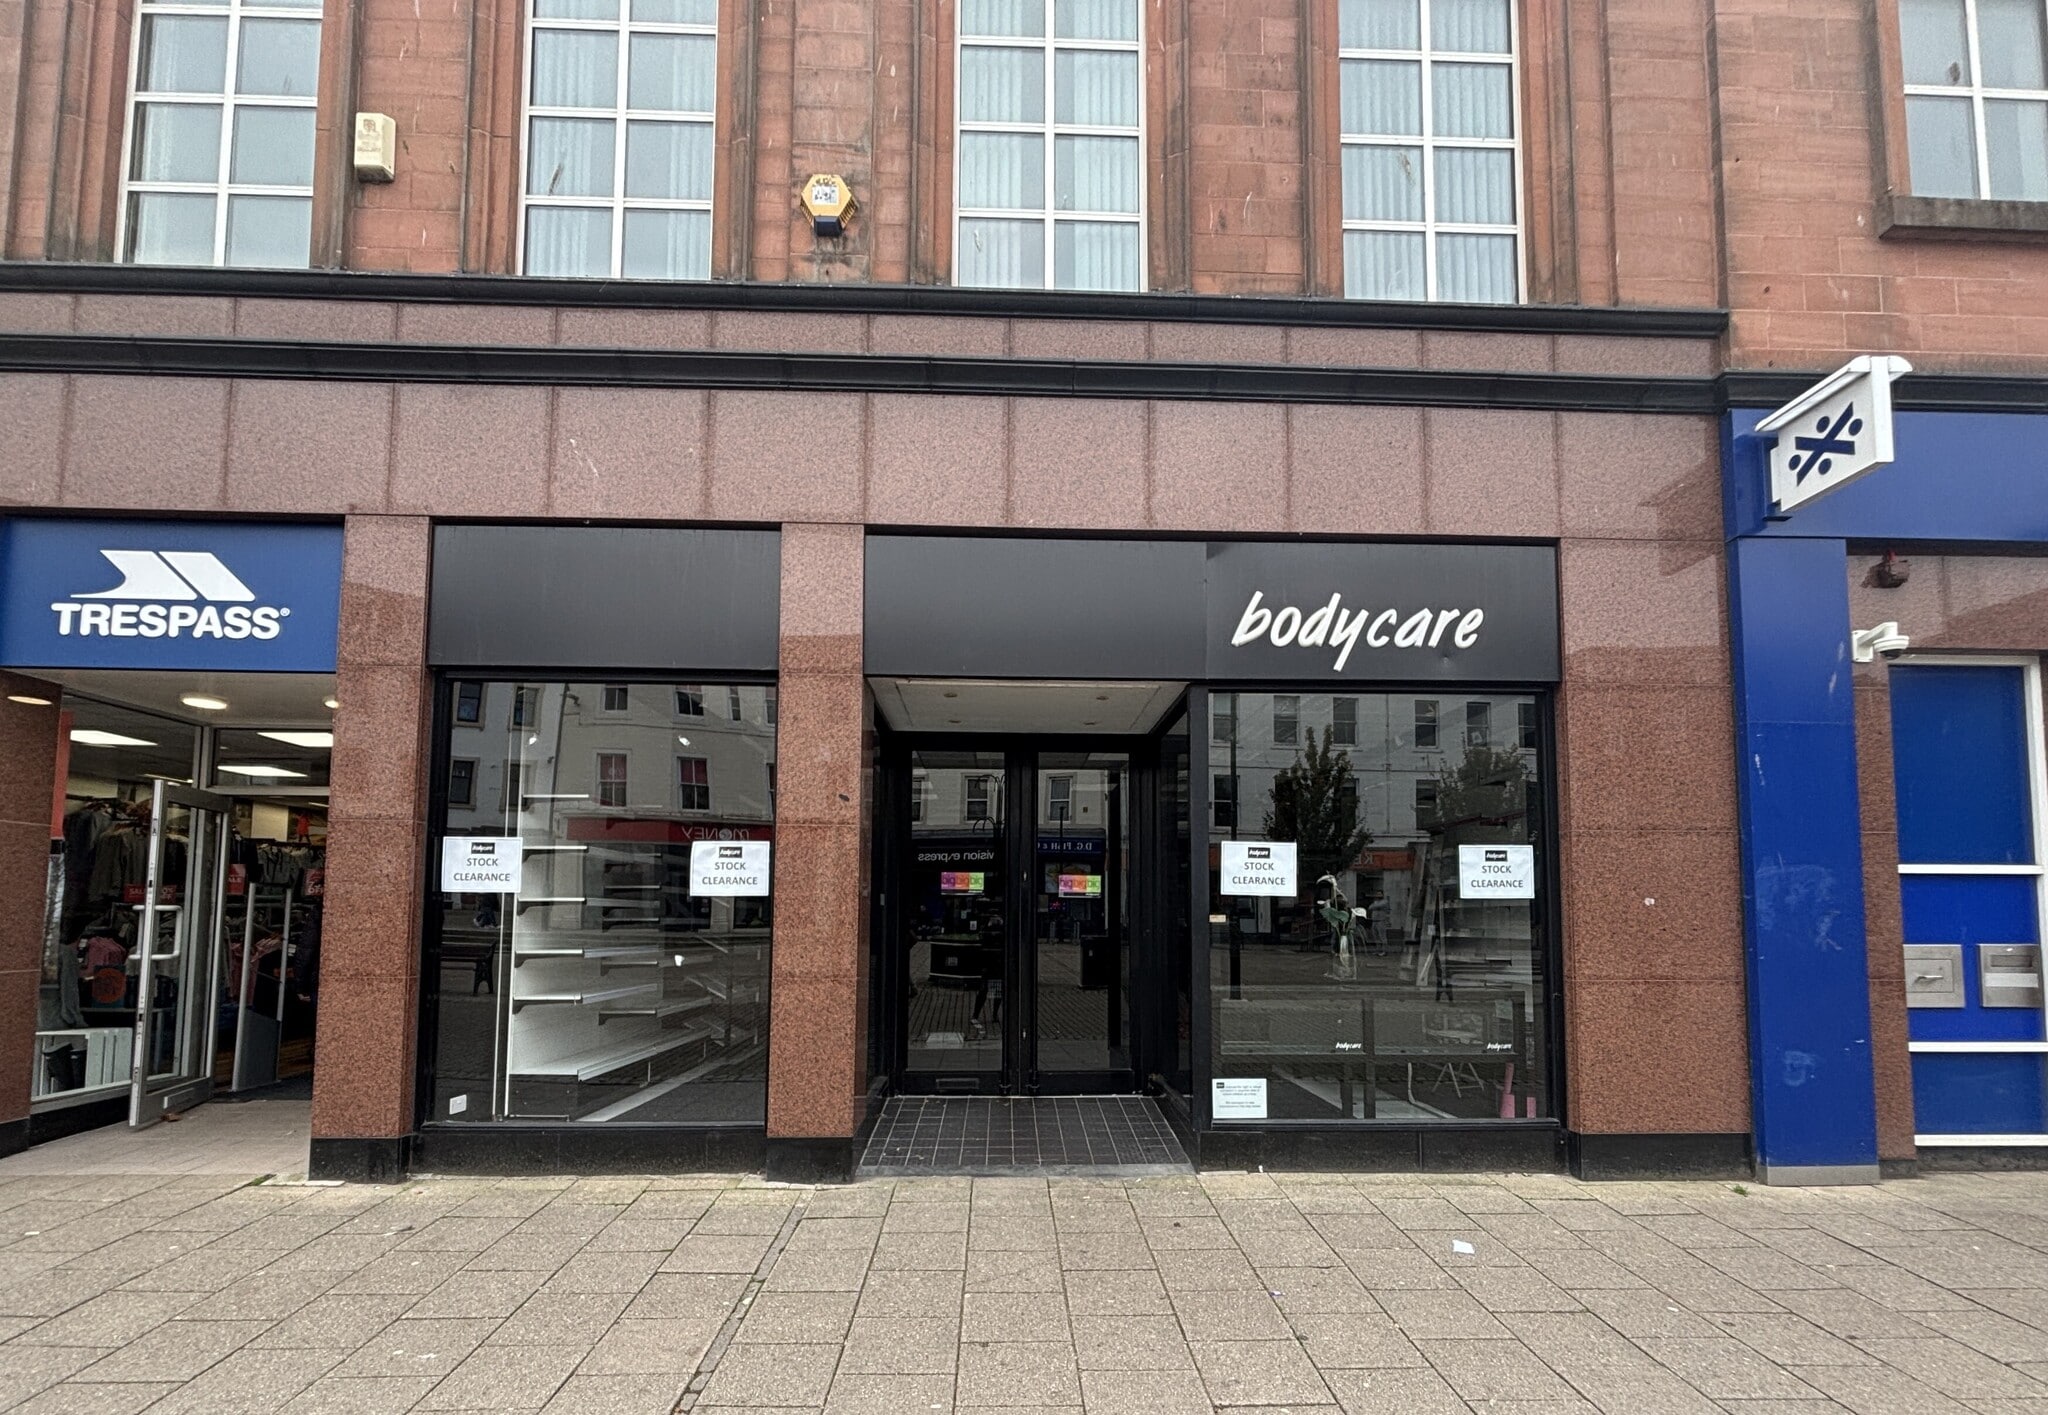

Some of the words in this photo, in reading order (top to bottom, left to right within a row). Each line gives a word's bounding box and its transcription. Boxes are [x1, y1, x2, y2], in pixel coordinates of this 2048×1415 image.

[51, 603, 281, 639] TRESPASS
[1231, 590, 1484, 672] bodycare
[466, 857, 499, 867] STOCK
[714, 862, 746, 870] STOCK
[1244, 862, 1275, 871] STOCK
[1481, 865, 1512, 874] STOCK
[453, 872, 511, 882] CLEARANCE
[702, 876, 758, 885] CLEARANCE
[1232, 876, 1286, 886] CLEARANCE
[1471, 879, 1524, 888] CLEARANCE
